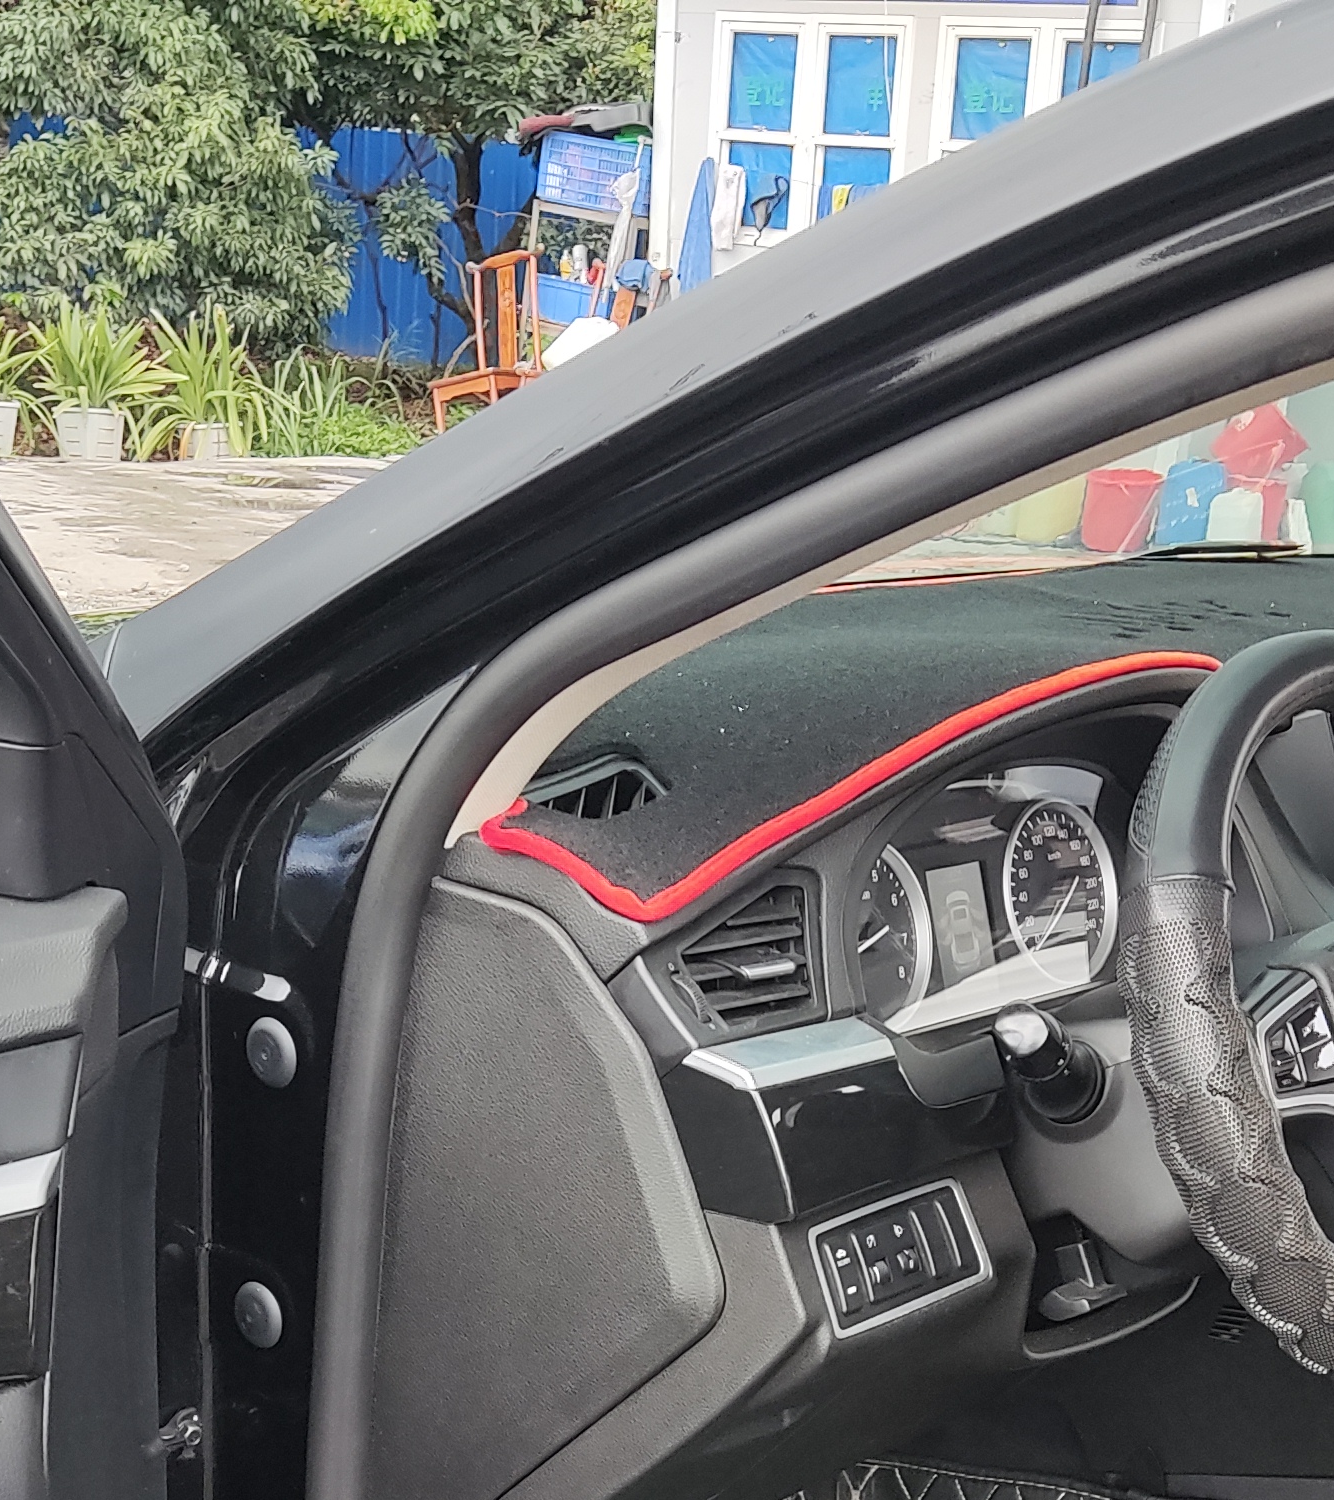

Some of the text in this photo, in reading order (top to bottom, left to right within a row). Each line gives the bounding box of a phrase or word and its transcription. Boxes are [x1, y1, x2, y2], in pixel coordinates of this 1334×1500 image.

[1043, 825, 1056, 837] 120
[1057, 828, 1068, 839] 140
[1031, 834, 1043, 846] 100
[871, 869, 879, 882] 5
[1018, 867, 1028, 879] 60
[1085, 877, 1098, 889] 200
[891, 893, 898, 906] 6
[1018, 891, 1028, 902] 40
[1087, 898, 1099, 910] 220
[1024, 915, 1035, 927] 20
[900, 932, 908, 946] 7
[898, 965, 906, 979] 8
